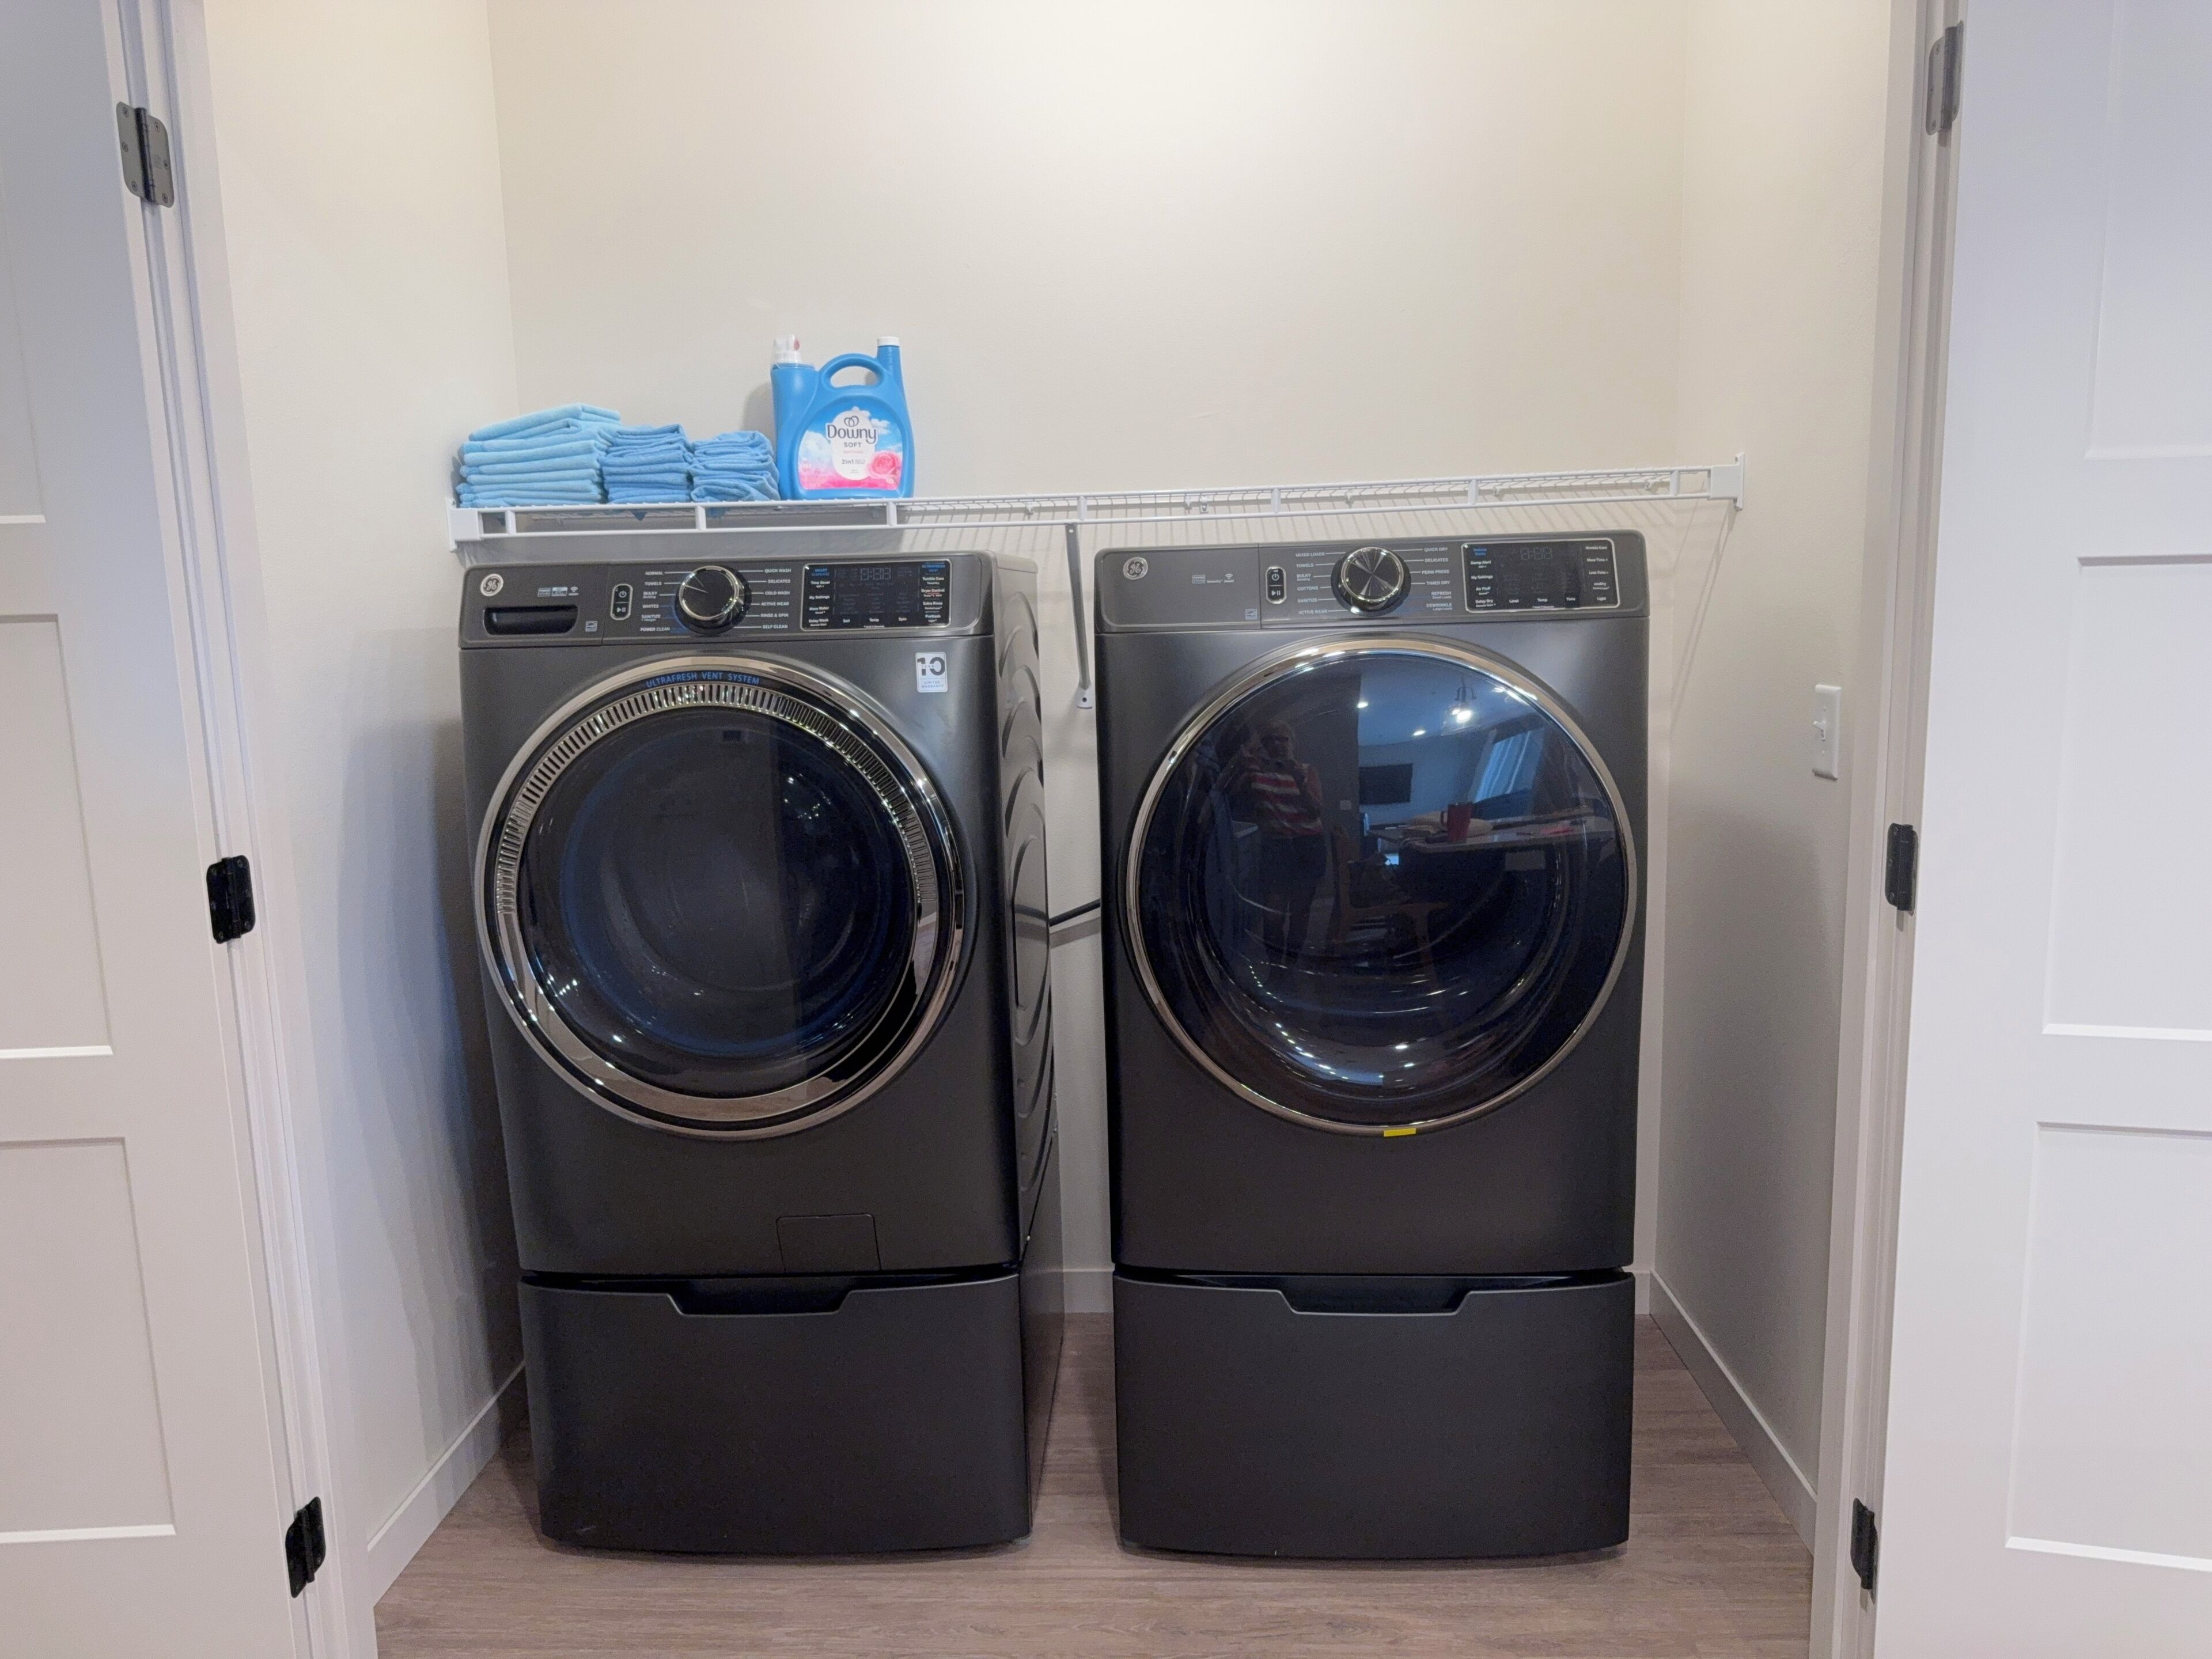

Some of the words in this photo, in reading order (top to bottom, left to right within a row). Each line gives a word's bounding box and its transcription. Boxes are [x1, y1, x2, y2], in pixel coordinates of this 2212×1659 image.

[827, 424, 876, 444] Downy
[917, 657, 945, 676] 10
[646, 672, 697, 688] ULTRAFRESH
[728, 673, 760, 685] SYSTEM
